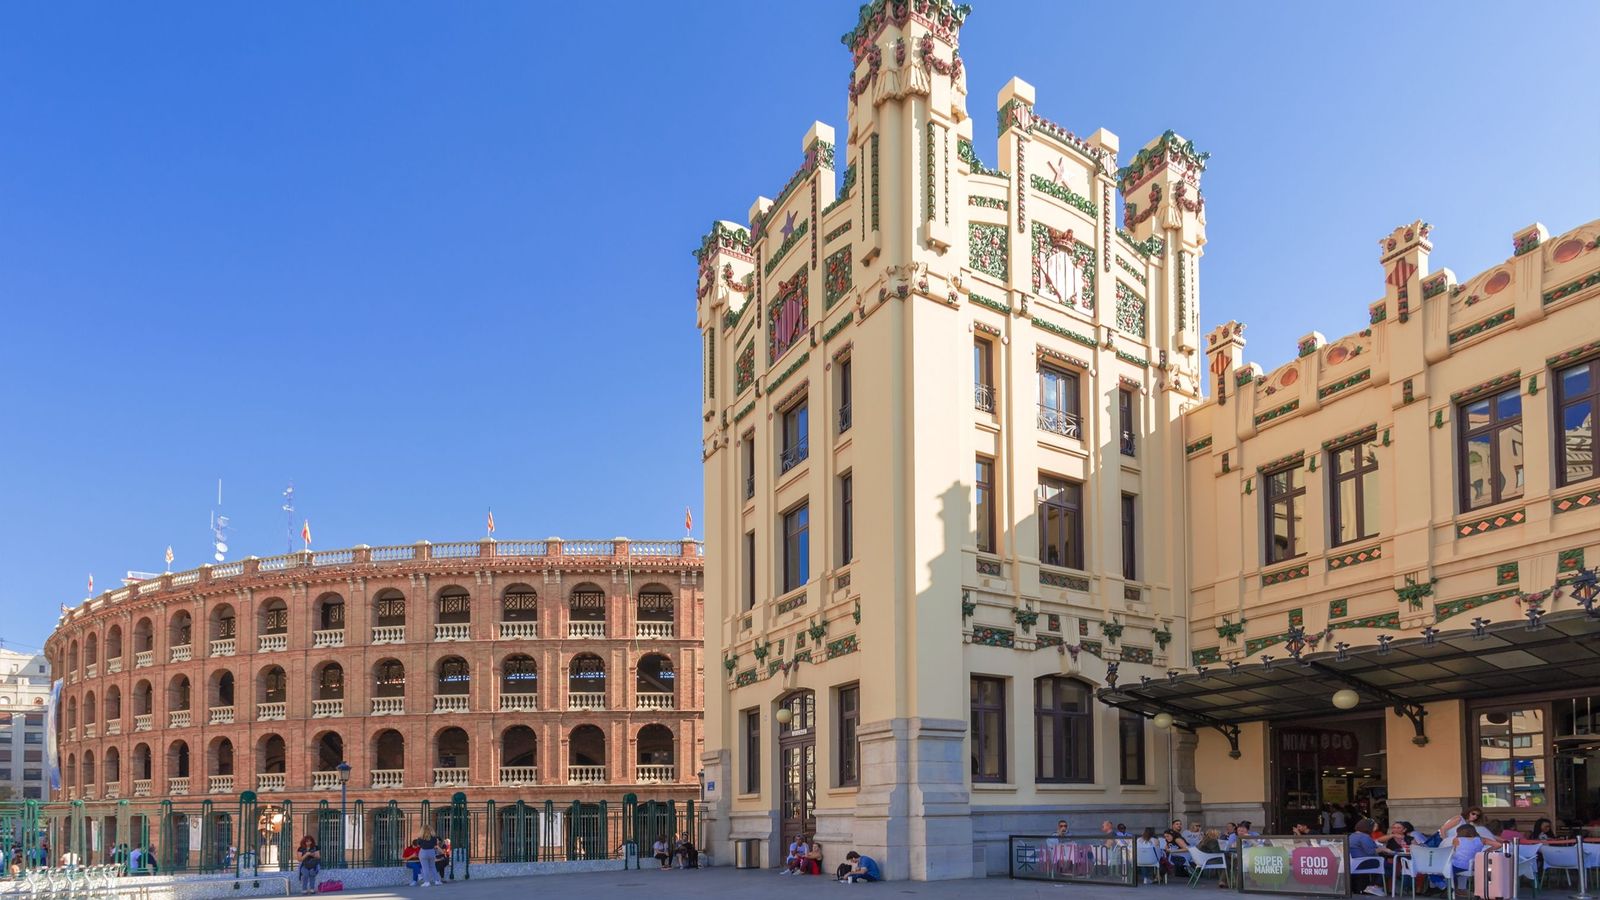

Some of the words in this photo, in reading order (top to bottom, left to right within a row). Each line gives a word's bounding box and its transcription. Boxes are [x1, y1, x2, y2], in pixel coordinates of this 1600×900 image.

[1039, 843, 1092, 875] AMAZ
[1093, 844, 1128, 878] TOO
[1254, 856, 1283, 866] SUPER
[1300, 856, 1328, 868] FOOD
[1254, 865, 1283, 874] MARKET
[1313, 868, 1328, 876] NOW
